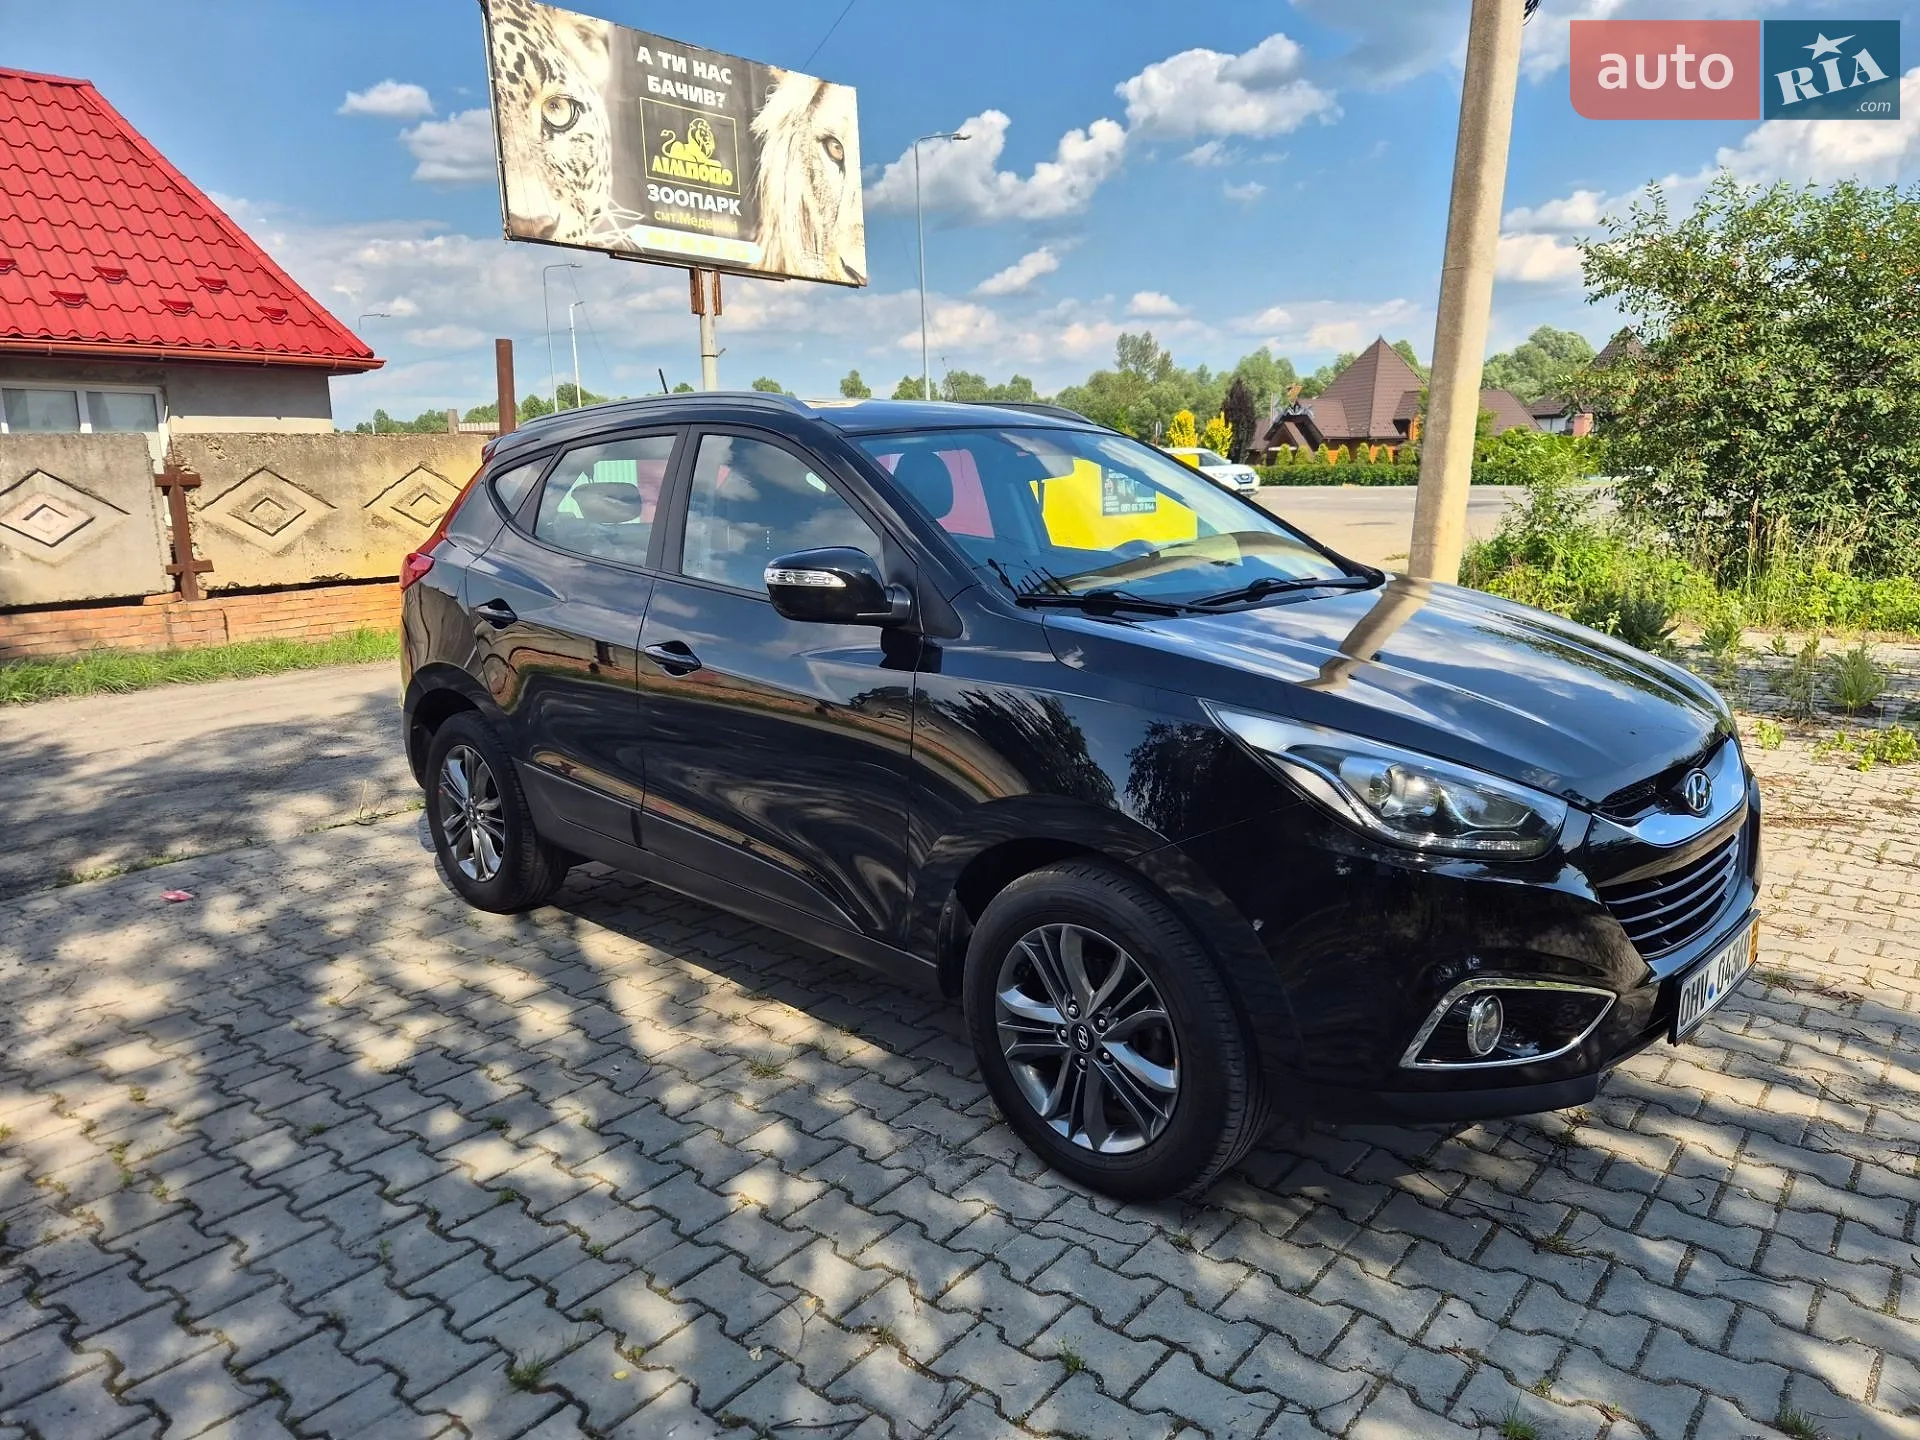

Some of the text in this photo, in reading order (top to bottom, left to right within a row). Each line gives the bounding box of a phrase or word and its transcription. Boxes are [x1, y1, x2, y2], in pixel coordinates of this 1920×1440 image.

[636, 46, 733, 86] А ТИ НАС
[646, 74, 727, 110] БАЧИВ?
[646, 183, 743, 217] ЗООПАРК
[1680, 970, 1709, 1027] OHV
